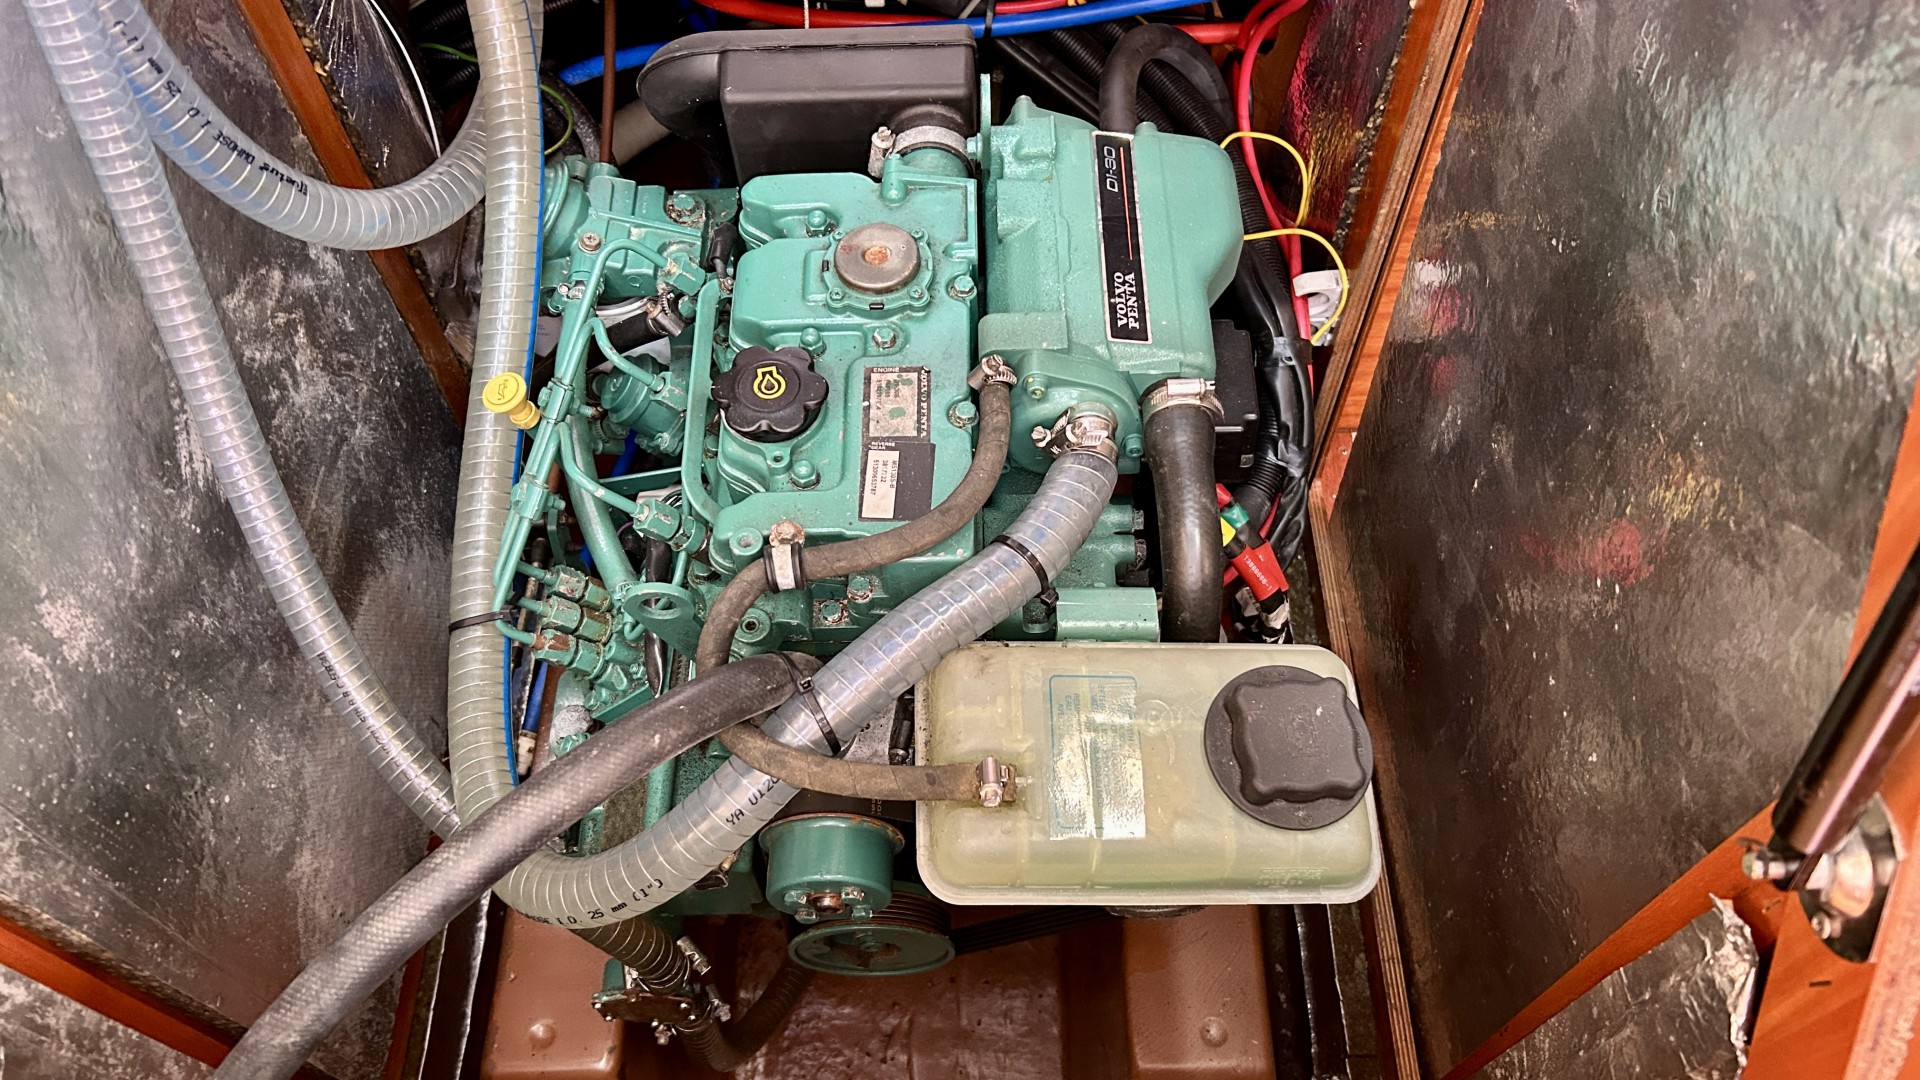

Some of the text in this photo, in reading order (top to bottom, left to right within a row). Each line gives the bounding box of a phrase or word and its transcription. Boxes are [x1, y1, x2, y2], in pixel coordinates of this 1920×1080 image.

[148, 57, 164, 75] mm
[164, 80, 181, 98] 25
[212, 130, 255, 165] DWHOSE
[1103, 146, 1118, 192] D1-30
[1113, 271, 1128, 328] VOLVO
[1124, 272, 1139, 330] PENTA
[920, 402, 928, 438] PENTA
[725, 808, 745, 825] YA
[555, 915, 582, 925] I.D.
[587, 906, 604, 920] 25
[611, 902, 627, 913] mm
[632, 878, 664, 902] (1")
